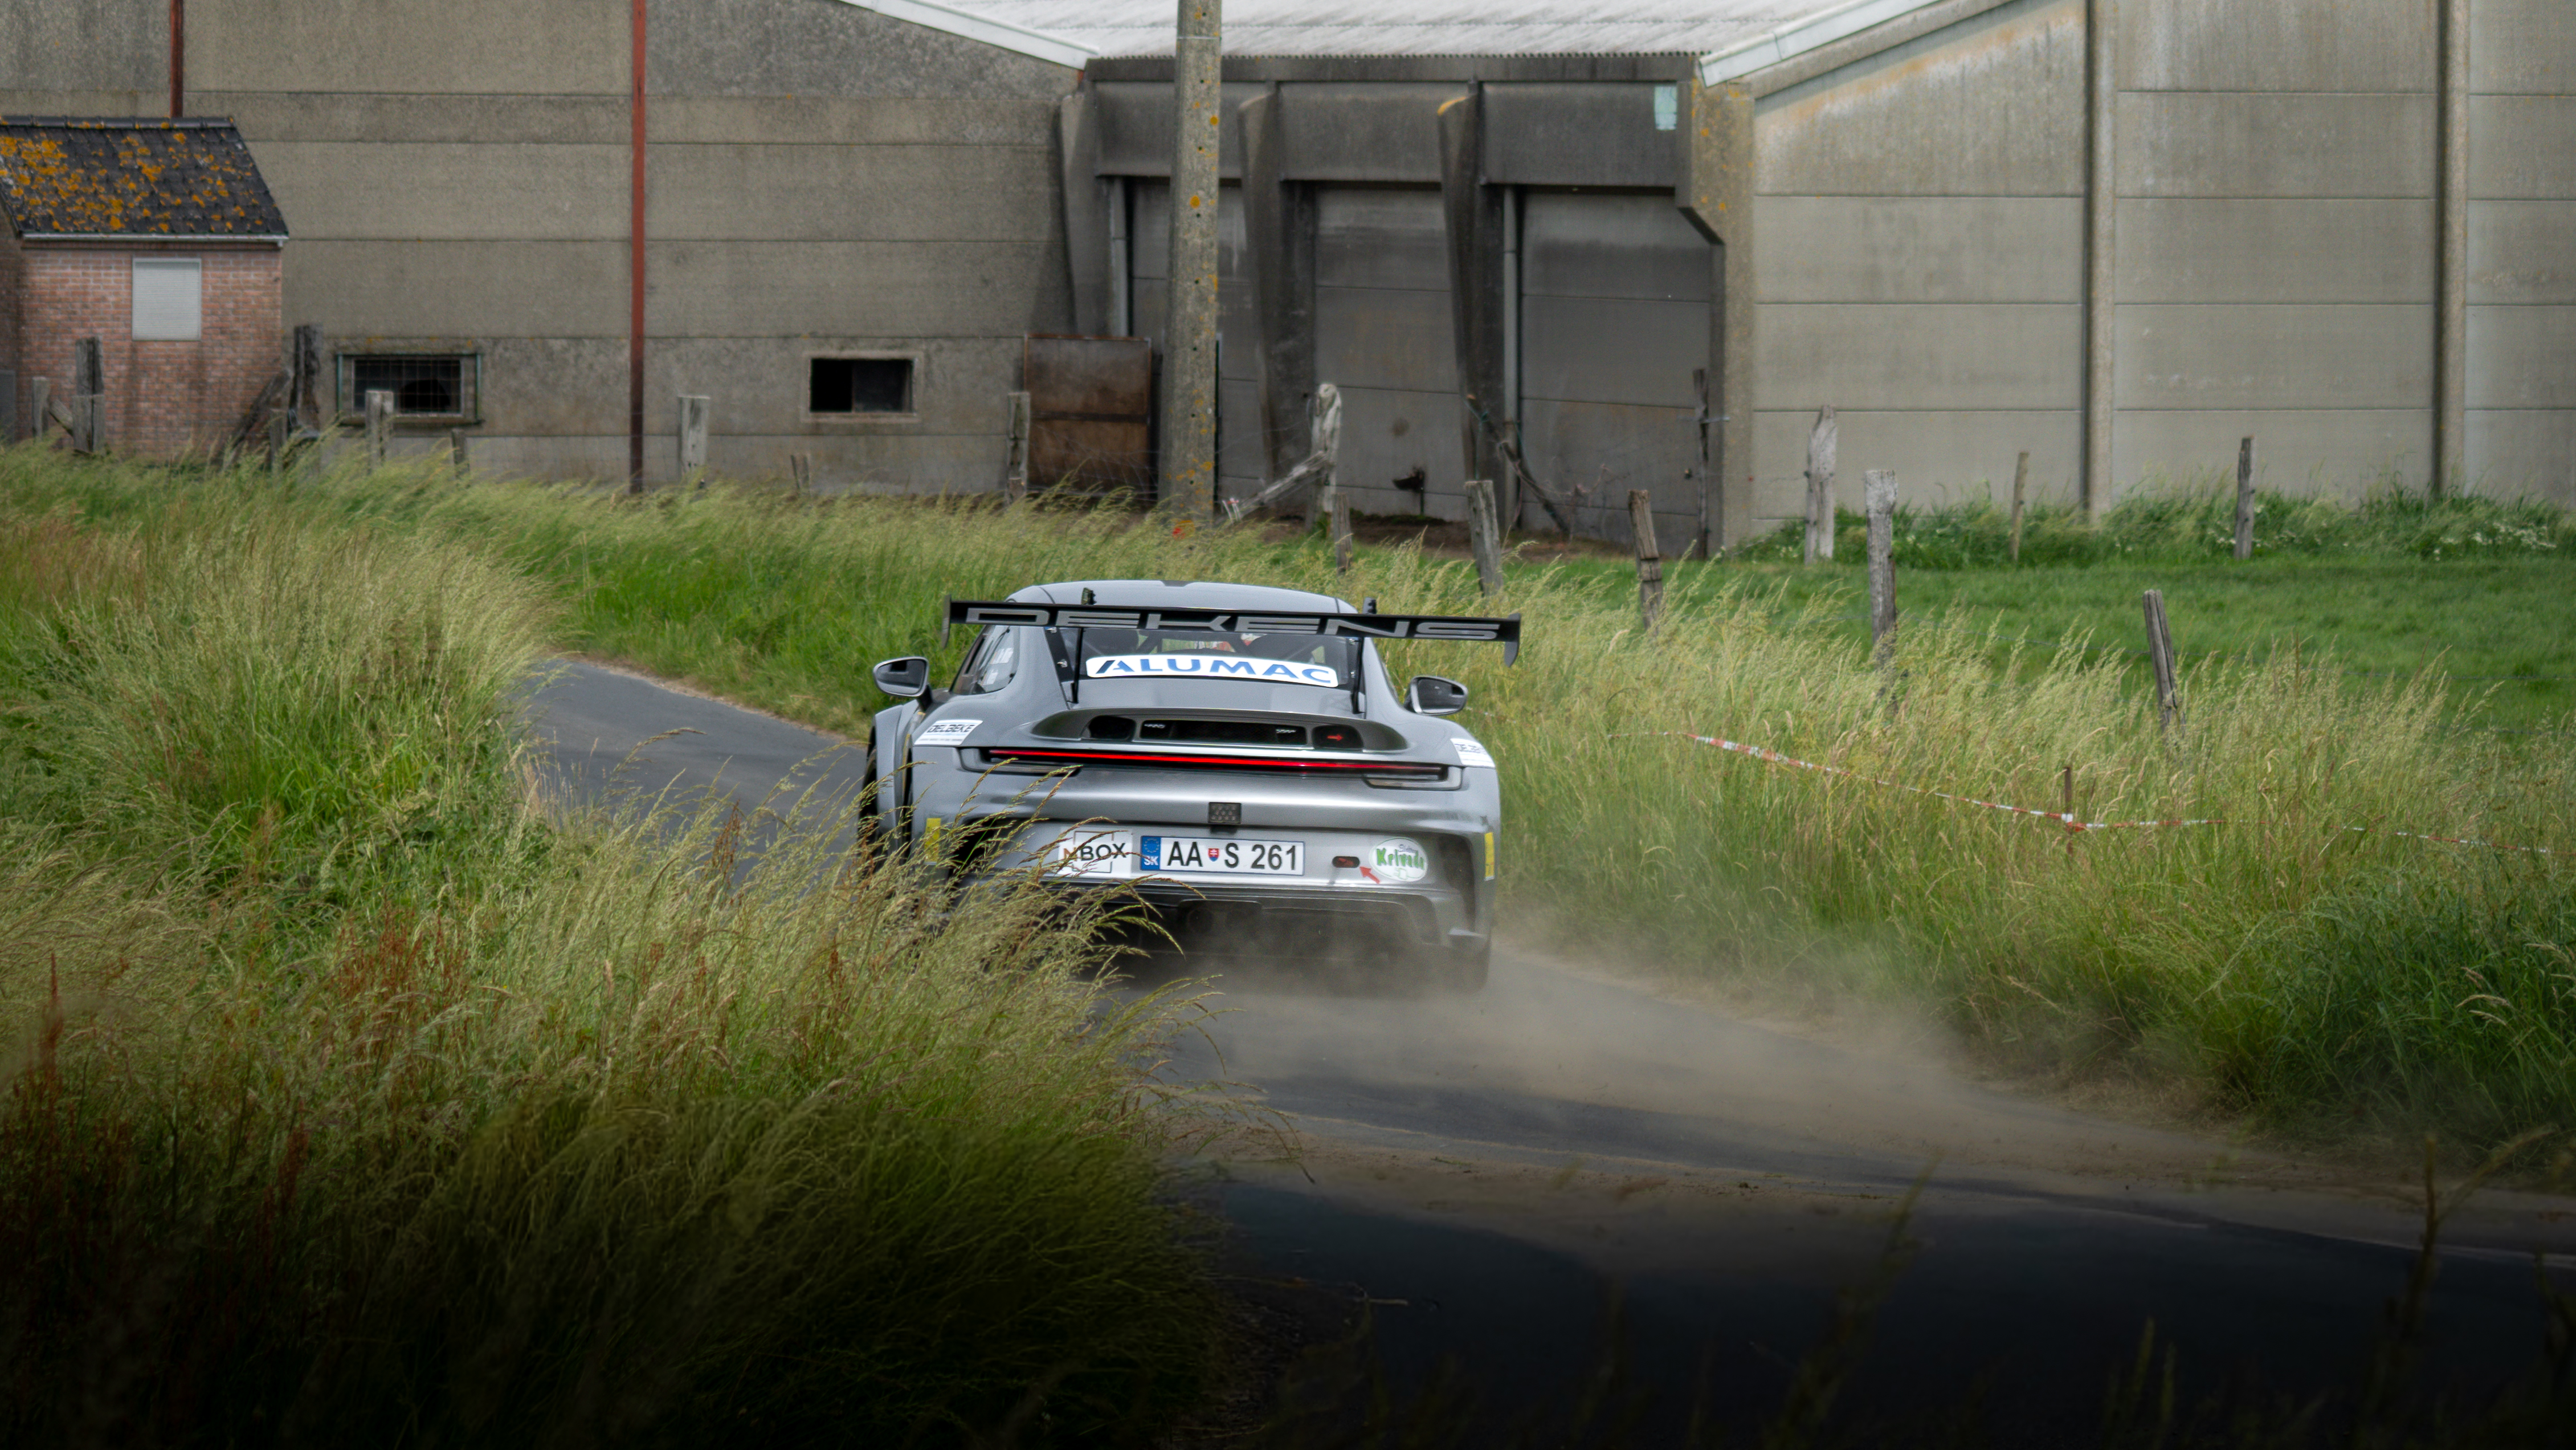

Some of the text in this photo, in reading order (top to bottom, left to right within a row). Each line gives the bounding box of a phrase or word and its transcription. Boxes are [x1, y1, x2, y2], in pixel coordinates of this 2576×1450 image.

[966, 608, 1500, 640] DEKENS
[1096, 658, 1331, 683] ALUMAC
[1144, 856, 1158, 866] SK
[1167, 841, 1296, 870] AA S 261
